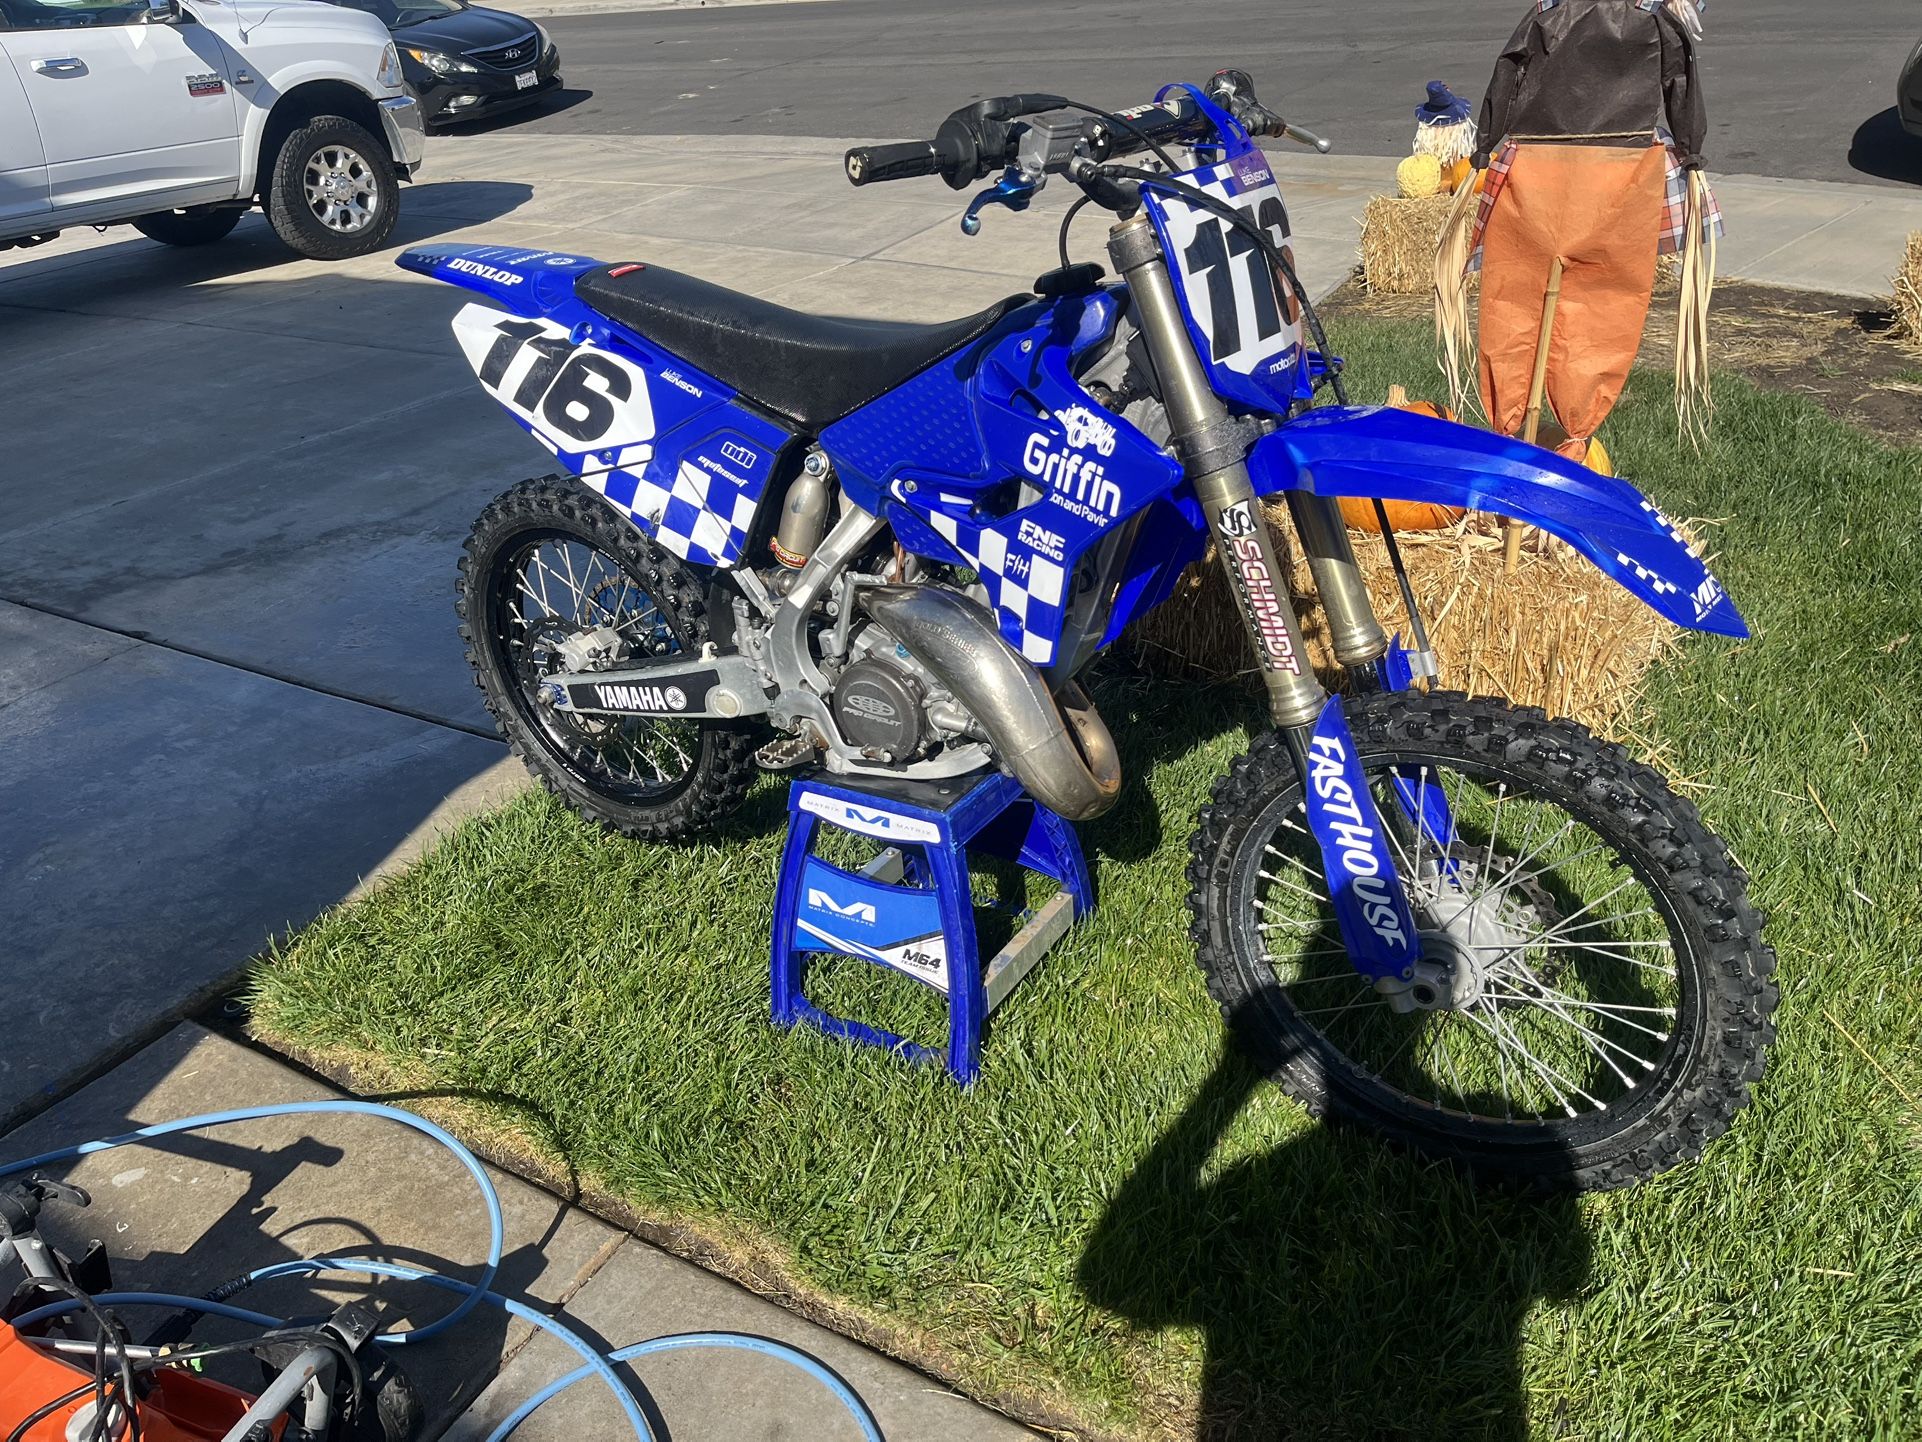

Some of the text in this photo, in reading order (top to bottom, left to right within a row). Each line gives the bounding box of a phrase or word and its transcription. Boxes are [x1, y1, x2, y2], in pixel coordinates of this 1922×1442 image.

[1240, 169, 1270, 186] BENSON
[447, 257, 524, 287] DUNLOP
[479, 320, 632, 442] 116
[660, 371, 703, 398] BENSON
[1023, 431, 1122, 518] Griffin
[1063, 499, 1083, 516] and
[1017, 531, 1064, 562] RACING
[1020, 518, 1066, 549] FNF
[1223, 538, 1273, 672] PERFORMANCE
[1231, 538, 1301, 677] SCHMIDT
[594, 684, 669, 711] YAMAHA
[806, 800, 840, 812] MATRIX
[896, 823, 931, 836] MATRIX
[808, 905, 876, 928] MATRIX CONCEPTS
[901, 959, 940, 975] TEAM ISSUE
[902, 948, 942, 970] M64
